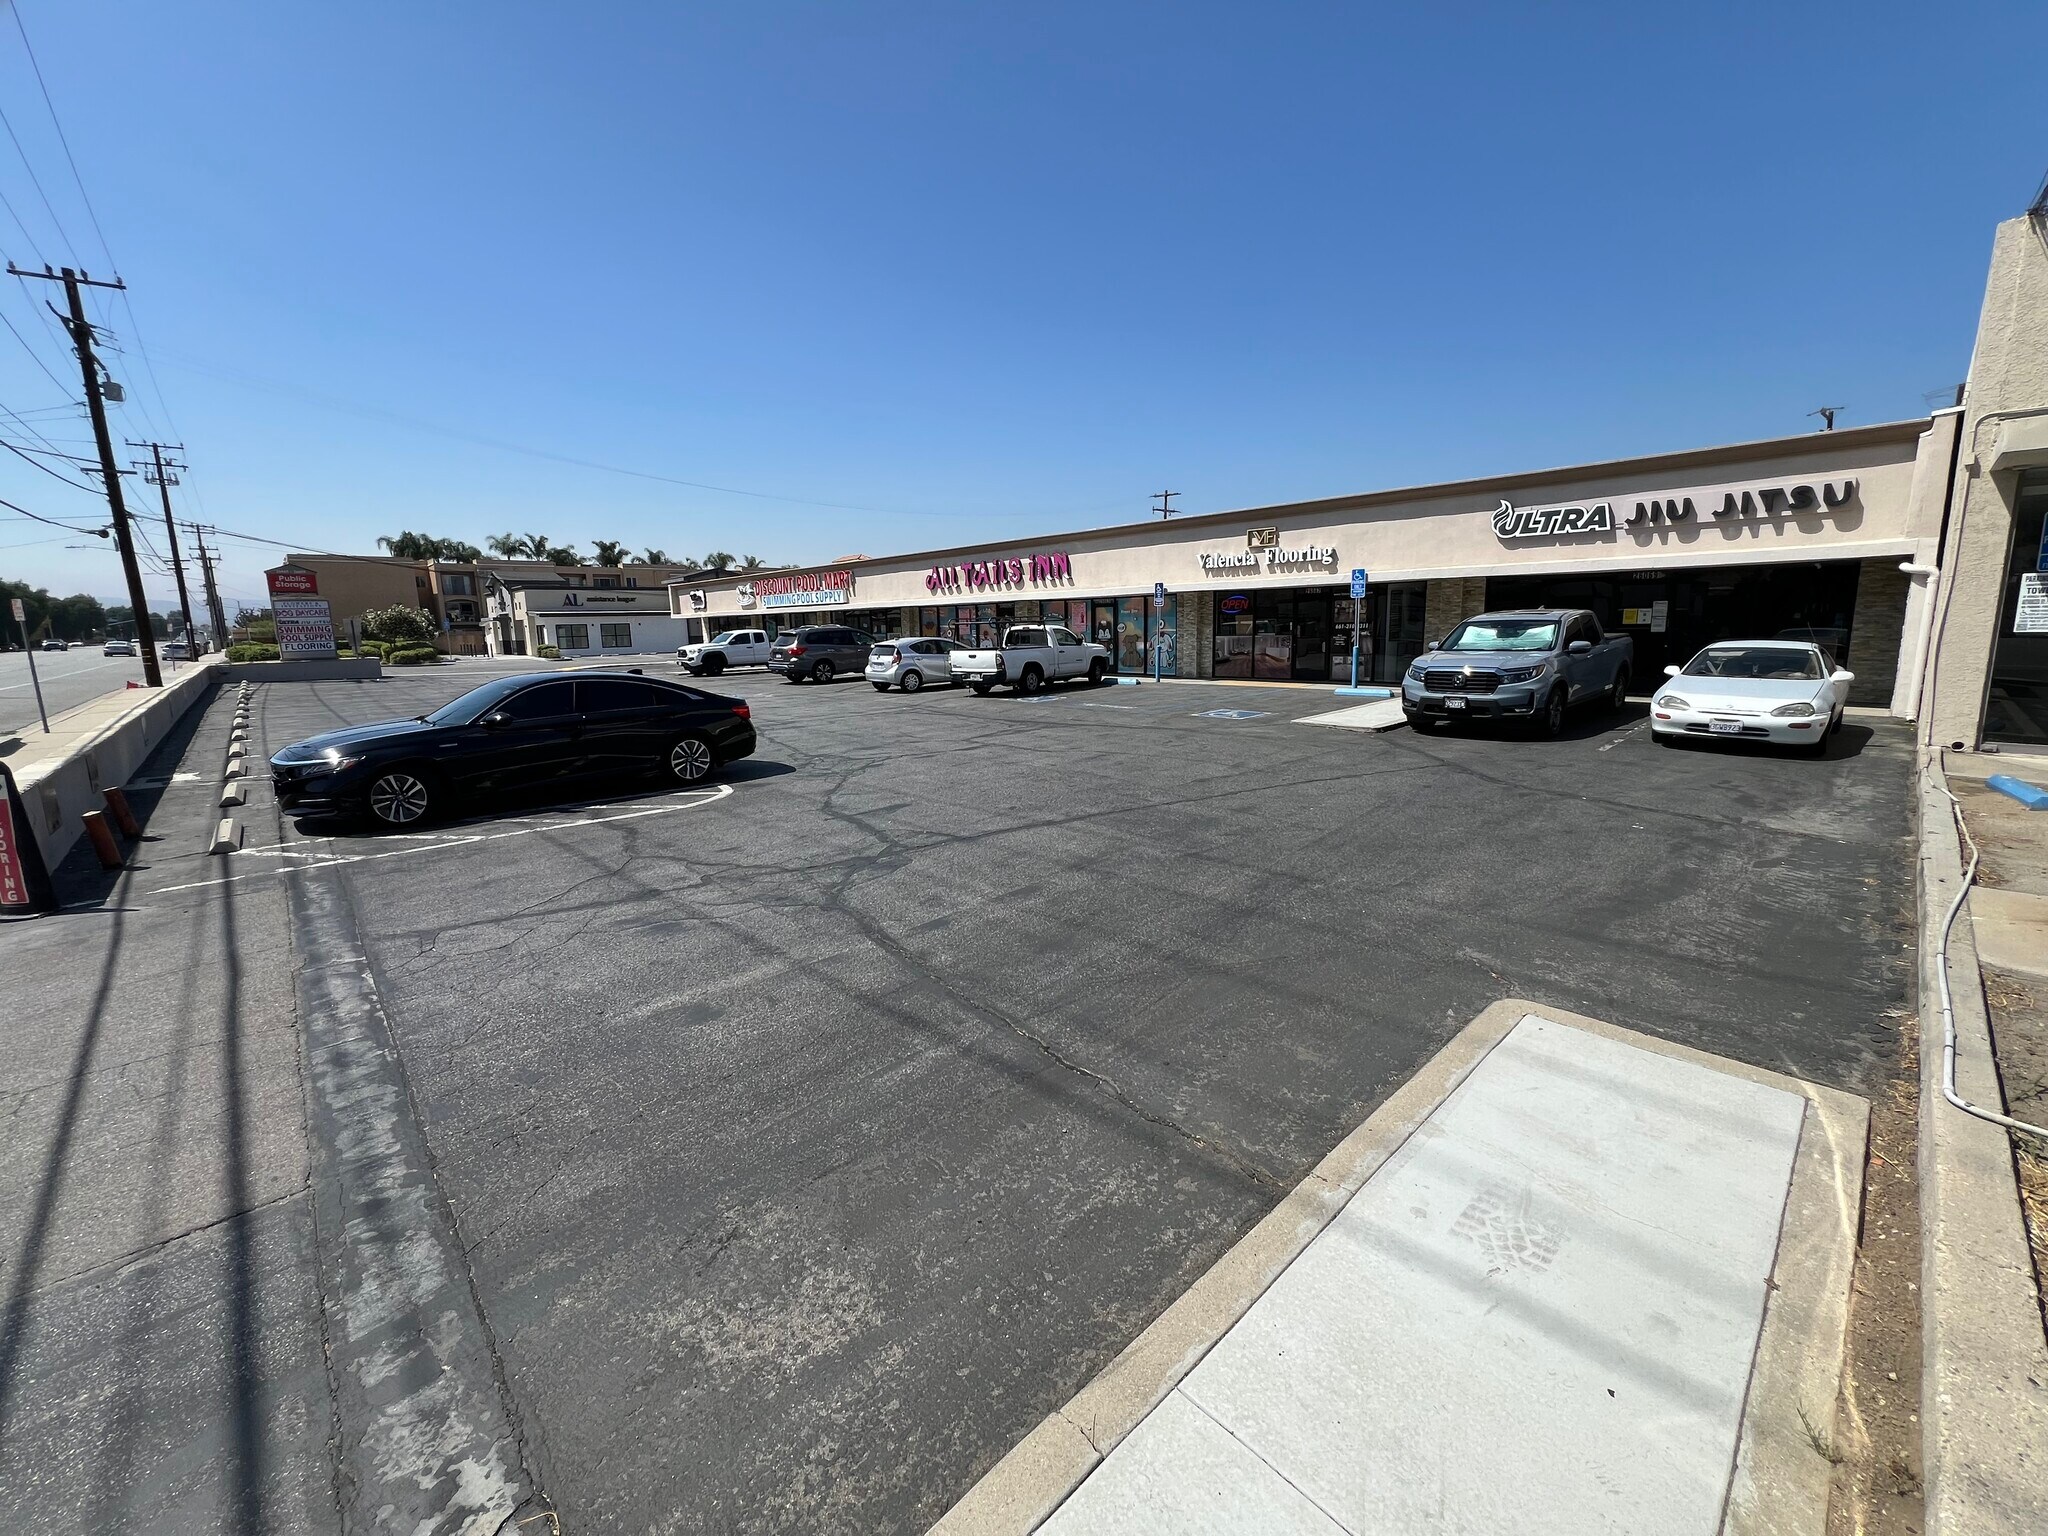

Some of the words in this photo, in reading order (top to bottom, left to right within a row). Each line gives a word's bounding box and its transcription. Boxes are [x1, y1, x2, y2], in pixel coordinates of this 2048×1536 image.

[1491, 500, 1611, 538] ULTRA
[1625, 497, 1693, 526] JIU
[1711, 481, 1854, 517] JITSU
[1196, 550, 1256, 568] Valencia
[1263, 544, 1333, 565] Flooring
[275, 581, 310, 589] Storage
[754, 577, 795, 596] DISCOUNT
[796, 573, 822, 592] POOL
[824, 570, 853, 590] MART
[562, 593, 584, 607] AL
[763, 594, 796, 607] SWIMMING
[796, 592, 814, 604] POOL
[815, 590, 842, 603] SUPPLY
[1221, 599, 1249, 610] OPEN
